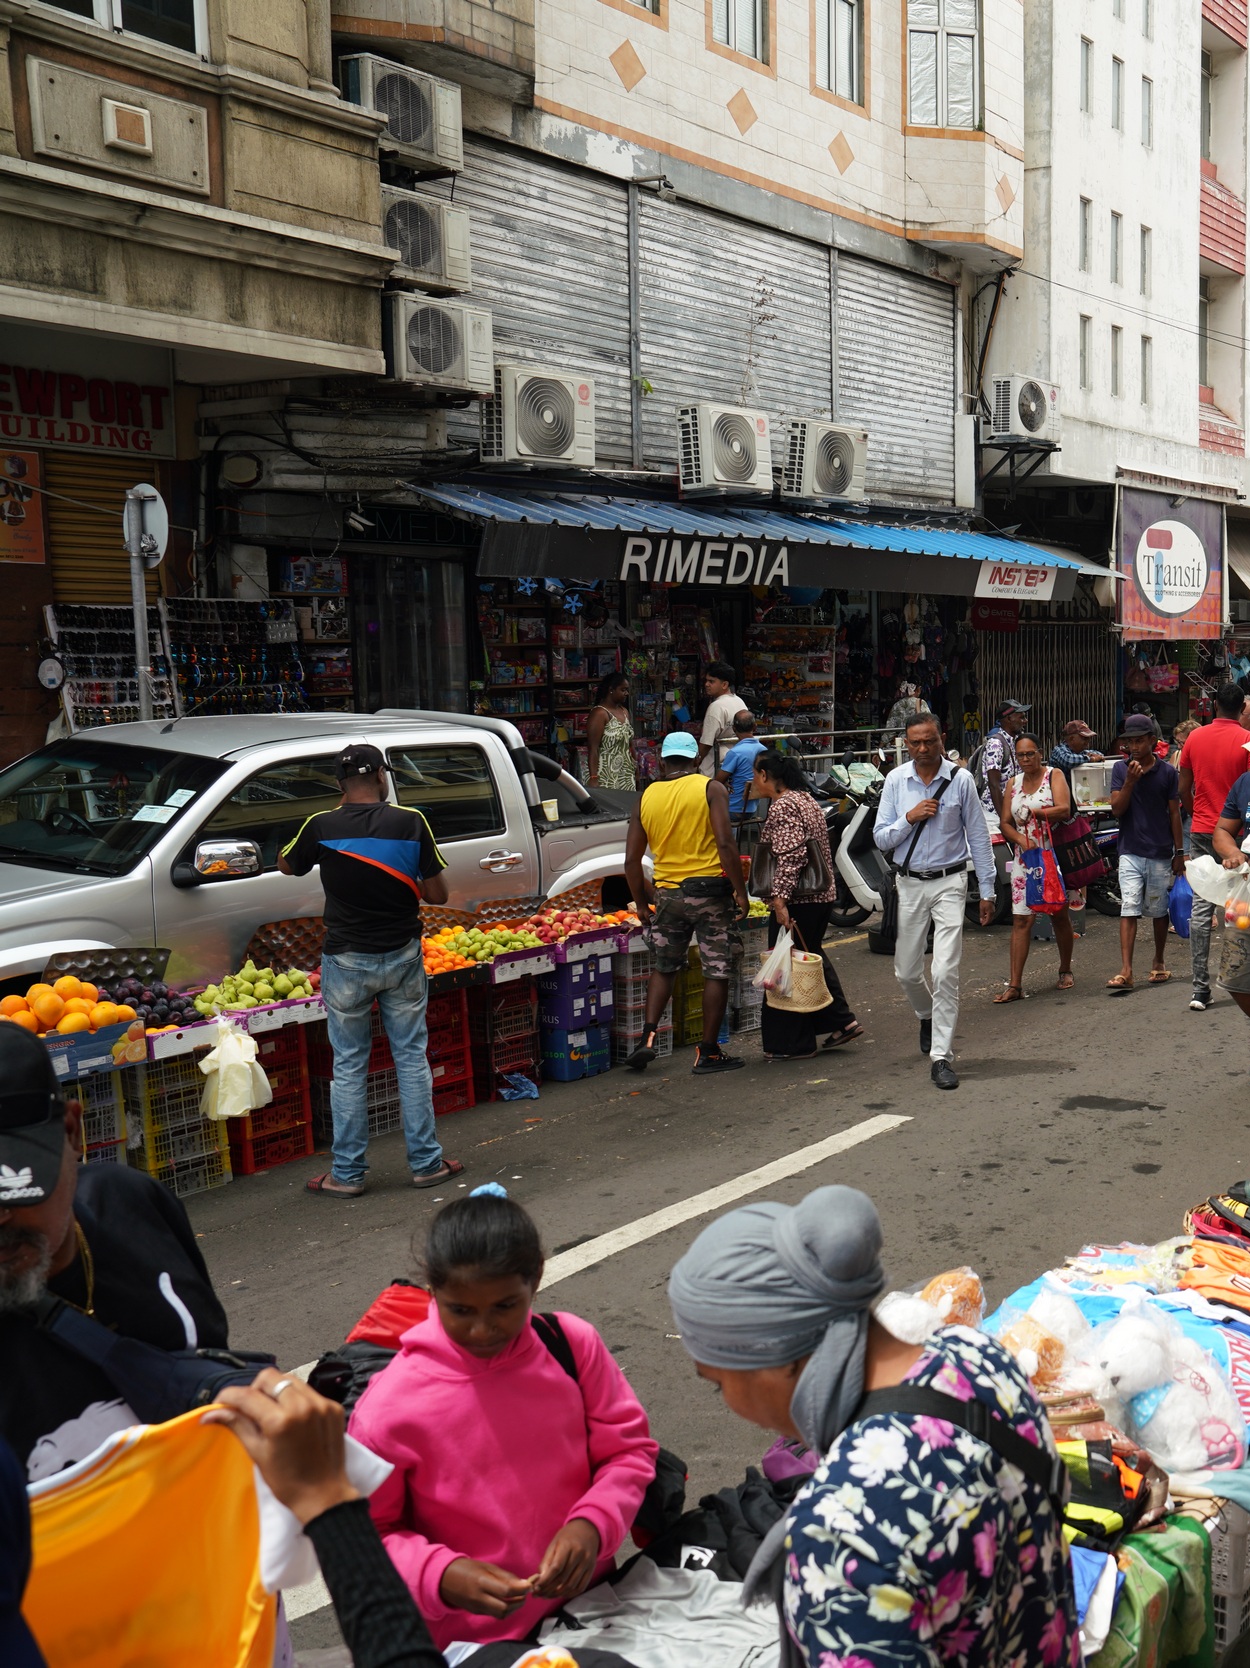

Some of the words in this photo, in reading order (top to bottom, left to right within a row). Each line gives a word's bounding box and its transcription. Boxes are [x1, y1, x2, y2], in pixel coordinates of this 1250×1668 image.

[619, 536, 789, 587] RIMEDIA
[1143, 555, 1202, 588] Transit
[988, 566, 1048, 587] INSTEP
[991, 608, 1016, 617] EMTEL
[1067, 839, 1099, 867] PINK
